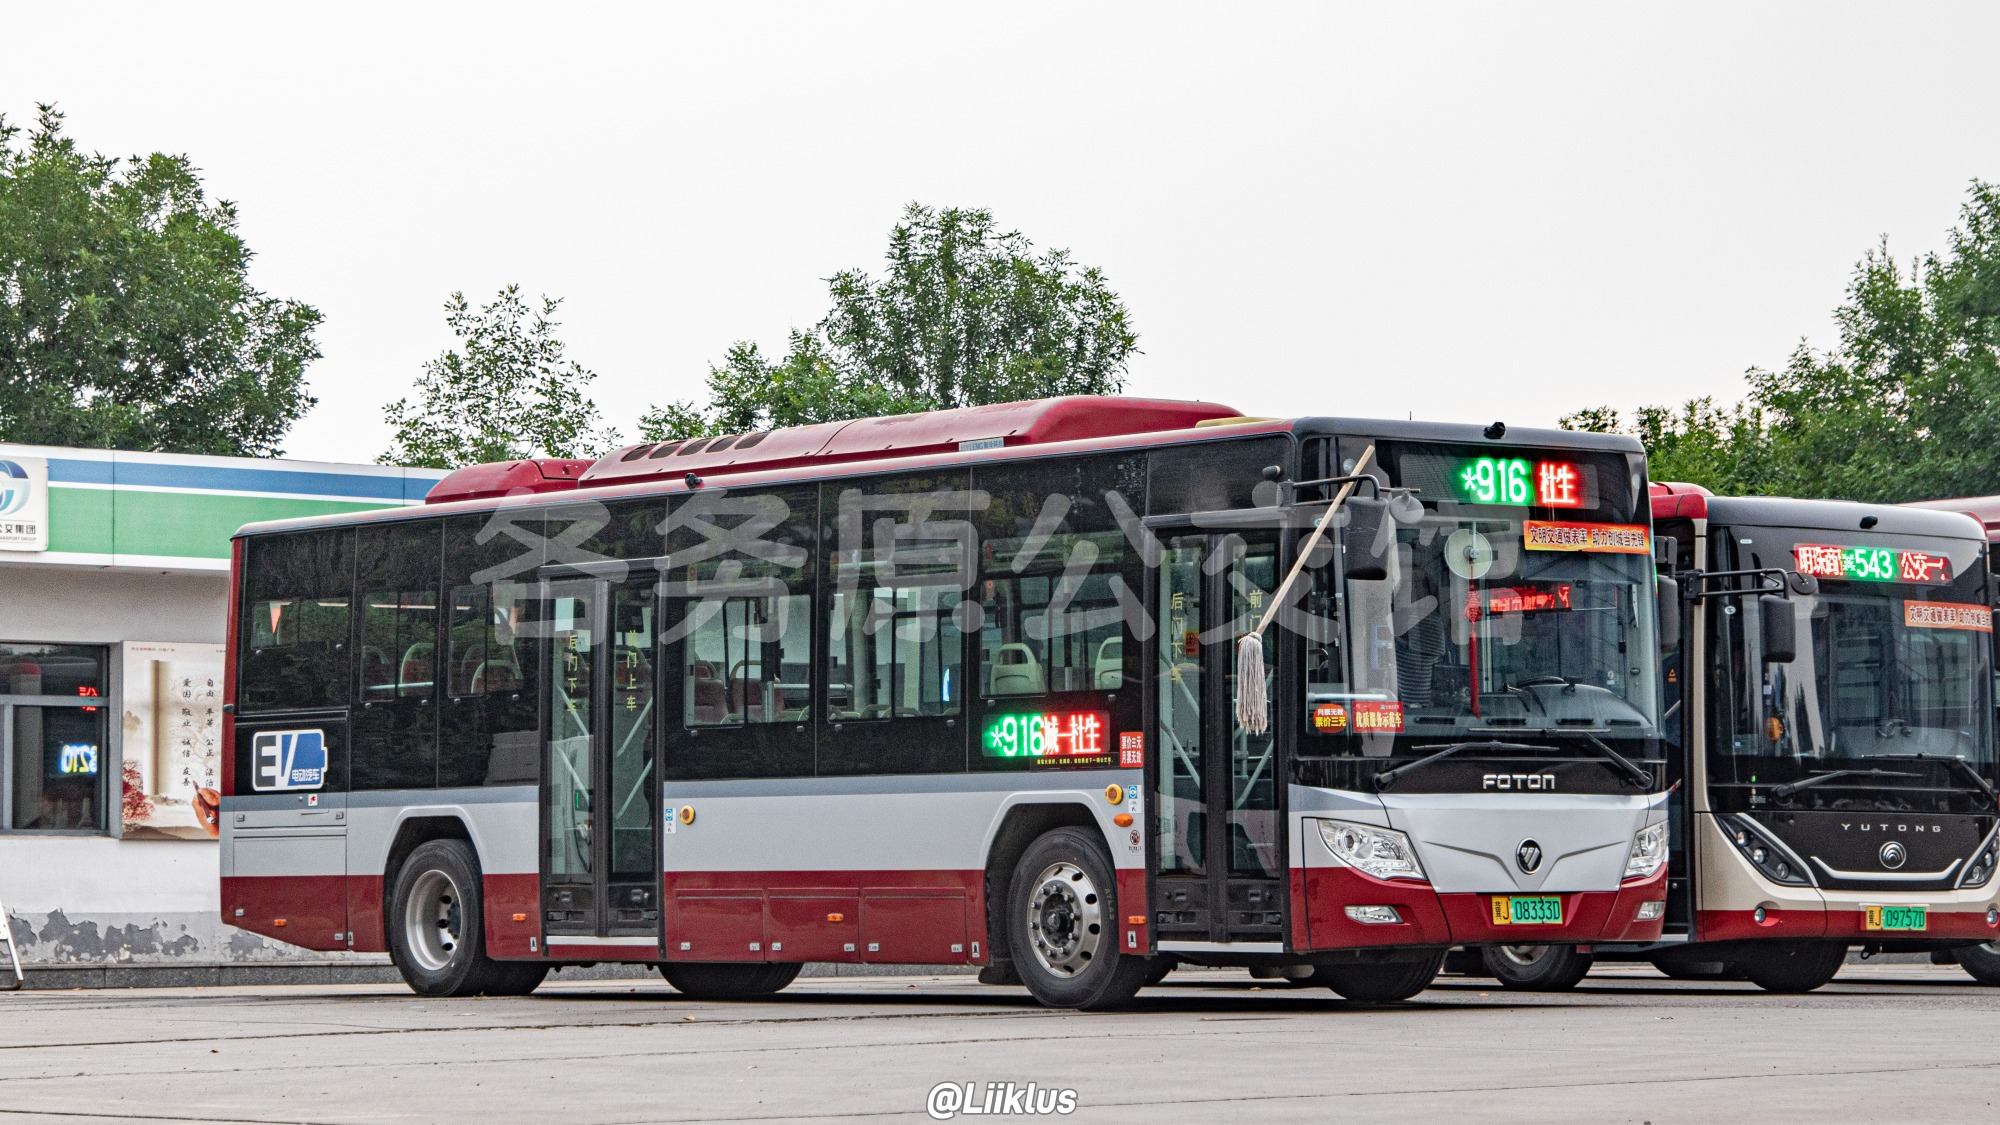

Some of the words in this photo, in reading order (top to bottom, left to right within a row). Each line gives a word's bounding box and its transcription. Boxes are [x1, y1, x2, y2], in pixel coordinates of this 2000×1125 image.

[0, 523, 36, 535] 交集团
[1530, 527, 1587, 545] 文明交通做表率
[1315, 716, 1347, 727] 票价三元
[1355, 711, 1402, 728] 优质服务示范车
[1121, 736, 1142, 750] 票价三元
[255, 733, 299, 789] EV
[292, 768, 320, 782] 电动汽车
[1482, 774, 1556, 790] FOTON
[1841, 823, 1941, 833] YUTONG
